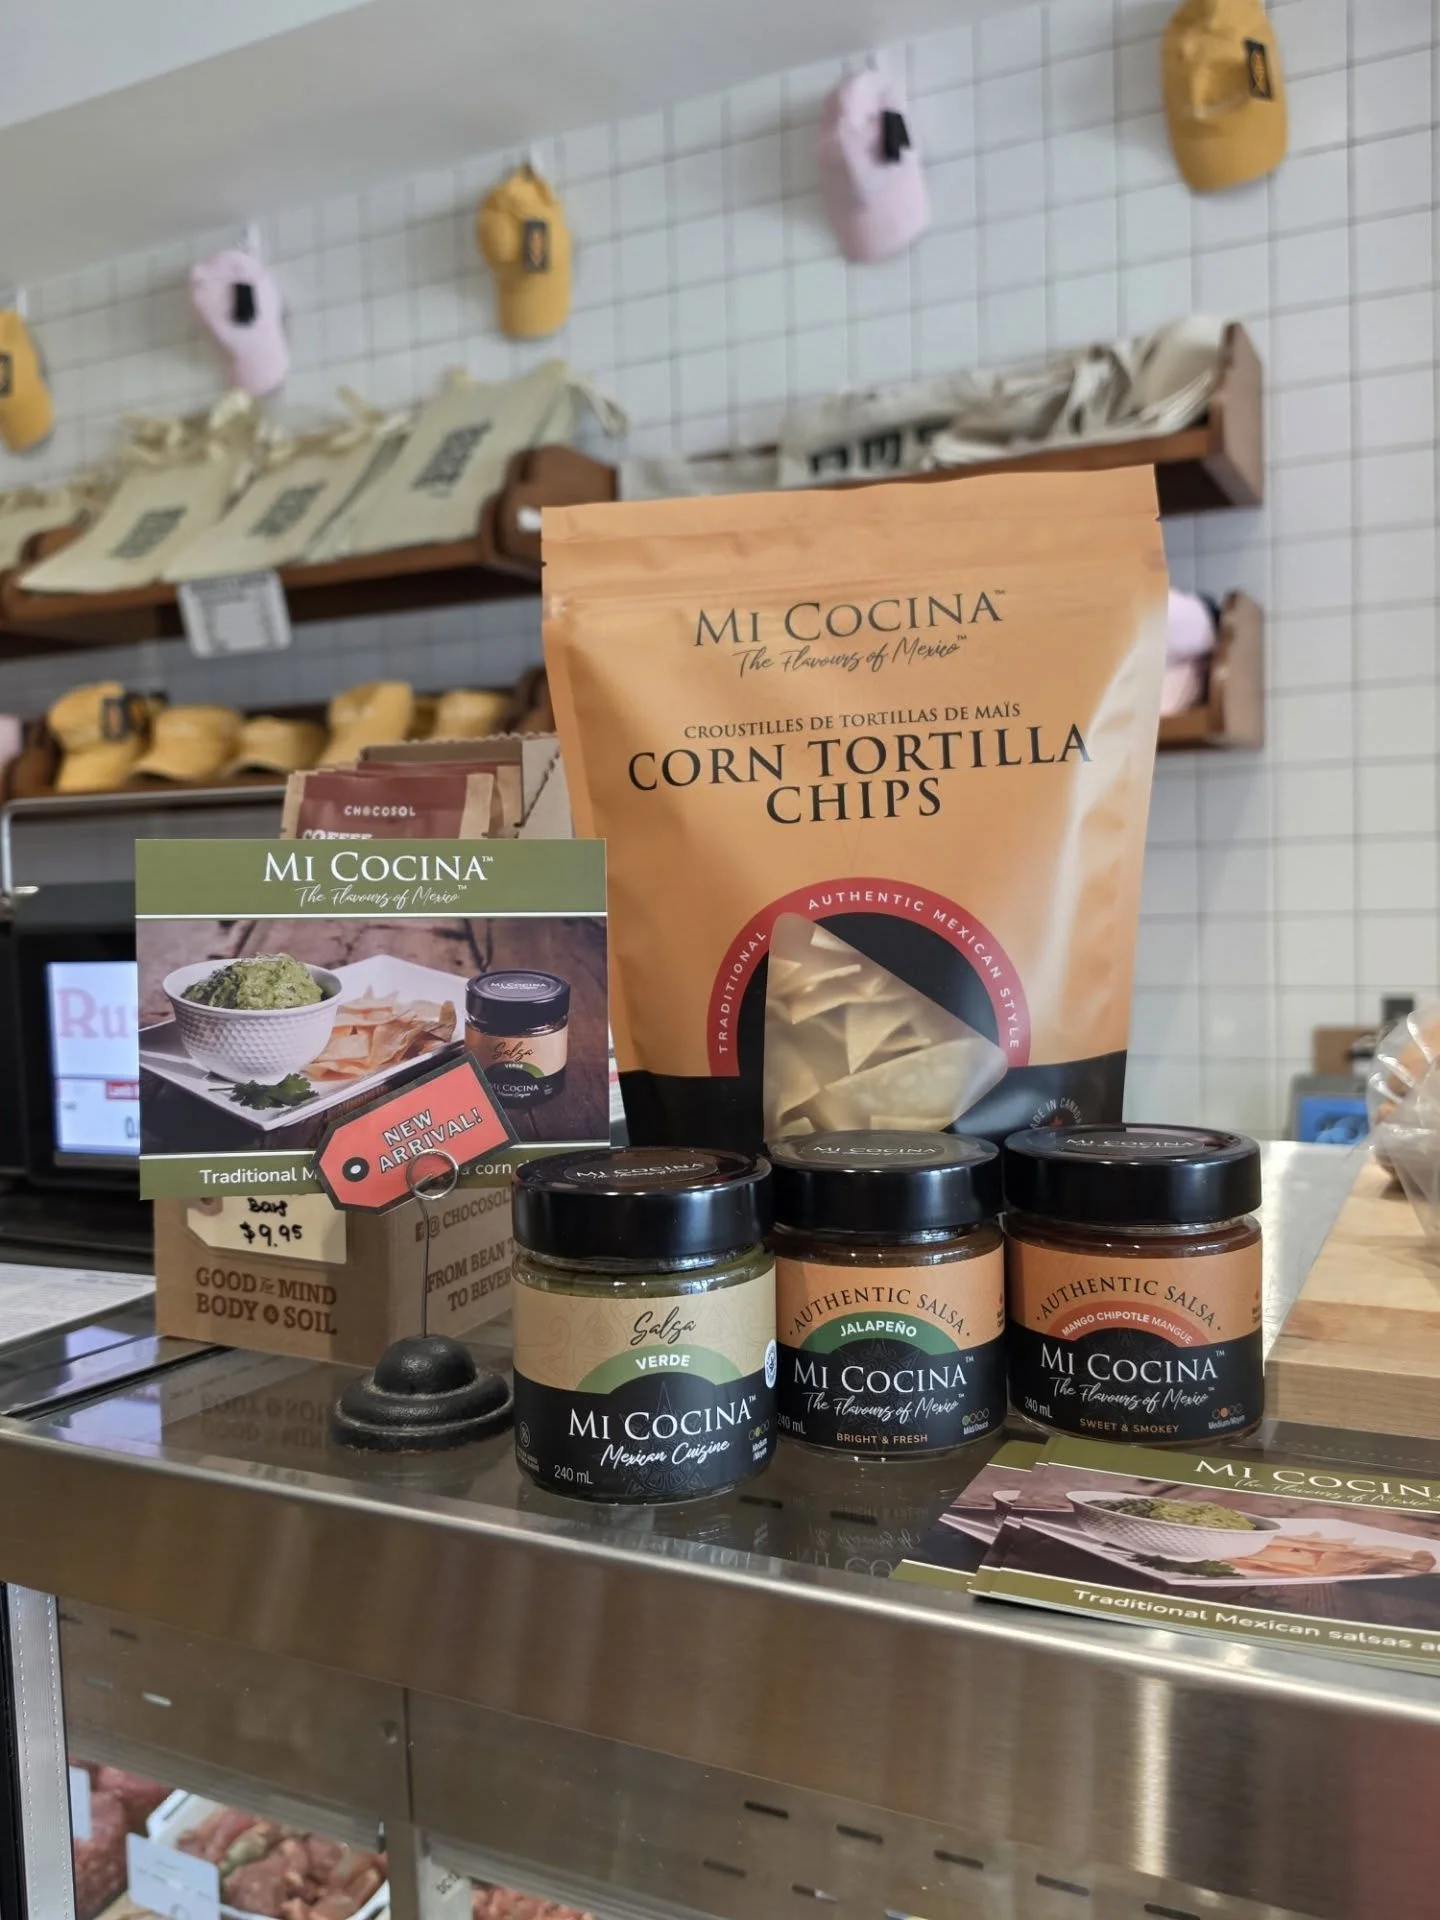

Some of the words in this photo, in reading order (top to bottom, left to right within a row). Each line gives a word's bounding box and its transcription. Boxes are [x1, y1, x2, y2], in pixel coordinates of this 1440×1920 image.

[732, 646, 774, 679] The
[782, 645, 865, 673] Flavours
[865, 642, 888, 673] of
[684, 718, 804, 739] CROUSTILLES
[810, 715, 834, 731] DE
[838, 707, 938, 729] TORTILLAS
[944, 705, 969, 721] DE
[975, 702, 1021, 719] MAÏS
[628, 743, 786, 791] CORN
[807, 723, 1093, 778] TORTILLA
[766, 777, 941, 825] CHIPS
[295, 884, 326, 908] The
[330, 883, 389, 908] Flavours
[392, 888, 408, 910] of
[719, 932, 767, 1054] TRADITIONAL
[808, 890, 924, 912] AUTHENTIC
[933, 909, 1002, 979] MEXICAN
[1000, 988, 1019, 1048] STYLE
[492, 1041, 534, 1061] Salsa
[378, 1107, 484, 1174] ARRIVAL!
[382, 1108, 433, 1147] NEW
[200, 1166, 298, 1185] Traditional
[475, 1163, 512, 1175] corn
[239, 1221, 303, 1247] $9.95
[427, 1258, 468, 1293] FROM
[471, 1241, 505, 1272] BEAN
[195, 1266, 256, 1293] GOOD
[278, 1278, 337, 1306] MIND
[448, 1287, 468, 1311] TO
[196, 1293, 259, 1321] BODY
[284, 1305, 338, 1335] SOIL
[793, 1286, 911, 1334] AUTHENTIC
[916, 1293, 965, 1336] SALSA
[1039, 1276, 1158, 1321] AUTHENTIC
[1164, 1285, 1216, 1330] SALSA
[630, 1306, 696, 1345] Salsa
[840, 1320, 917, 1337] JALAPEÑO
[1062, 1315, 1095, 1337] MANGO
[1096, 1311, 1149, 1323] CHIPOTLE
[1152, 1317, 1193, 1344] MANGUE
[635, 1354, 690, 1370] VERDE
[801, 1391, 829, 1413] The
[833, 1395, 896, 1422] Flavours
[894, 1403, 911, 1424] of
[1040, 1403, 1053, 1419] mL
[1049, 1376, 1076, 1398] The
[1079, 1383, 1140, 1411] Flavours
[1142, 1391, 1160, 1413] of
[793, 1420, 807, 1434] mL
[837, 1433, 877, 1444] BRIGHT
[881, 1435, 889, 1445] &
[893, 1433, 928, 1445] FRESH
[1080, 1418, 1117, 1431] SWEET
[1122, 1424, 1129, 1433] &
[1133, 1424, 1180, 1434] SMOKEY
[601, 1443, 667, 1470] Mexican
[672, 1440, 730, 1466] Cuisine
[554, 1465, 574, 1481] 240
[576, 1472, 594, 1486] mL
[1272, 1470, 1440, 1498] COCIN
[1074, 1588, 1208, 1621] Traditional
[1215, 1612, 1321, 1638] Mexican
[1328, 1628, 1413, 1648] salsas
